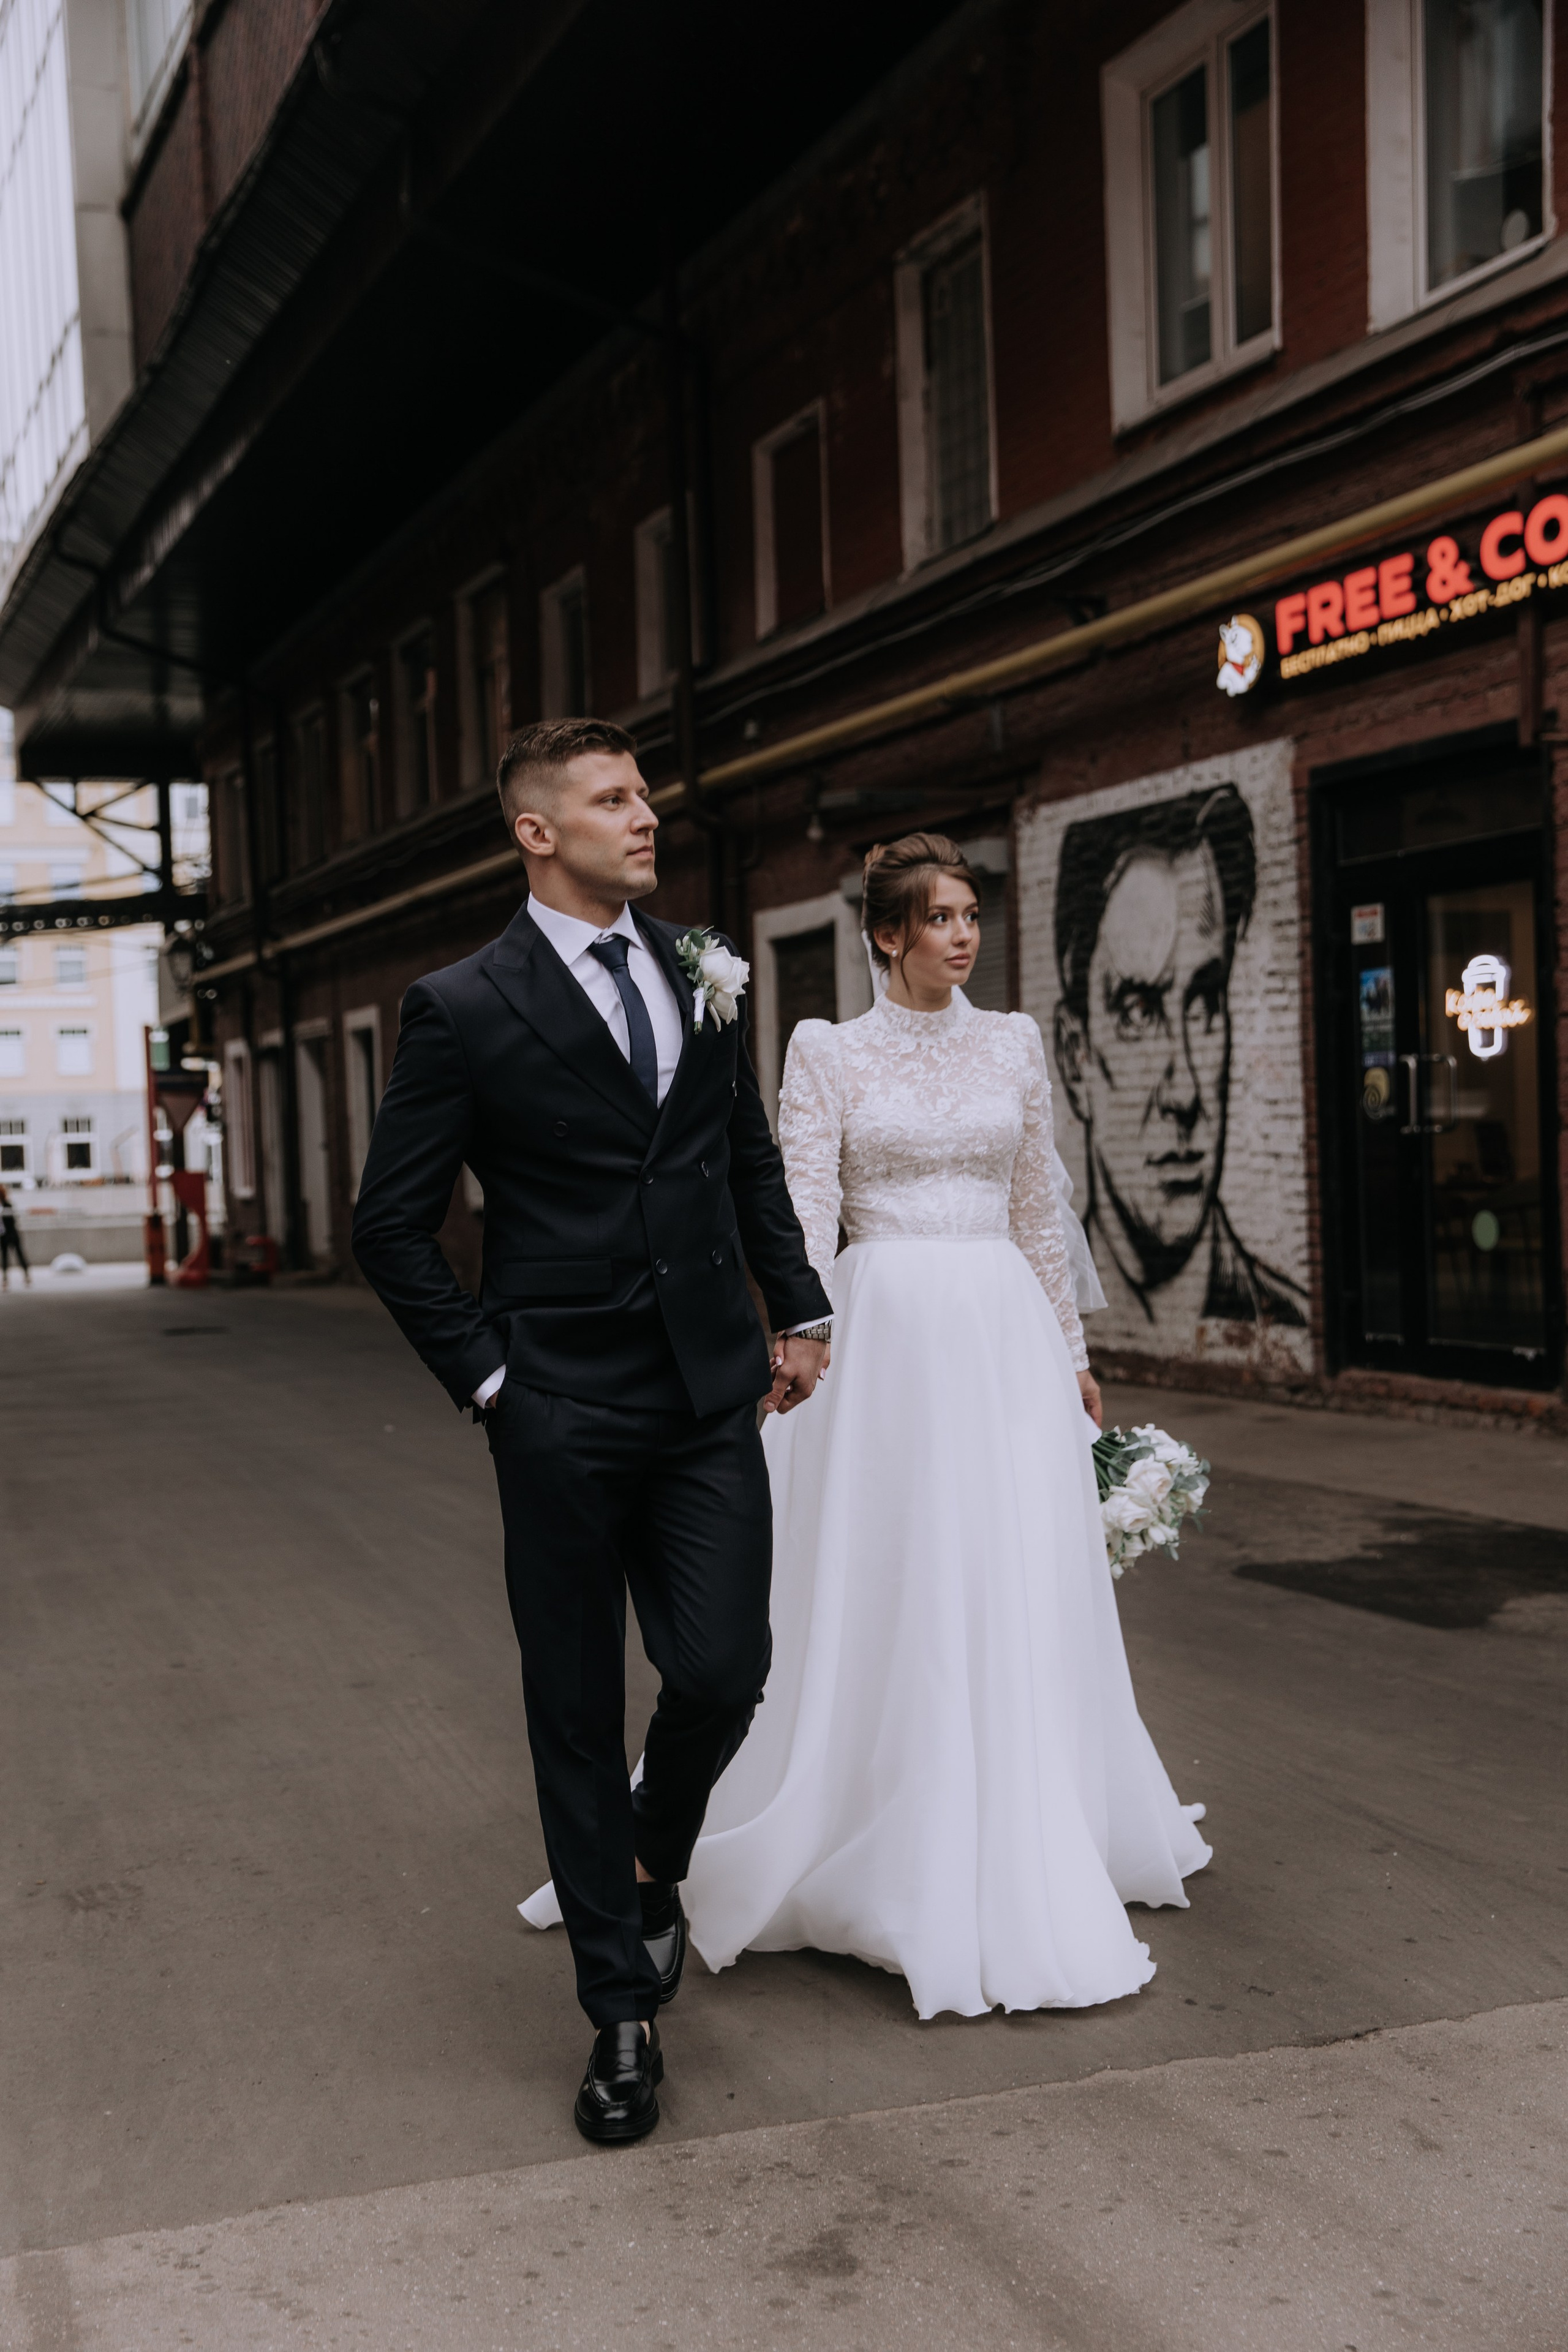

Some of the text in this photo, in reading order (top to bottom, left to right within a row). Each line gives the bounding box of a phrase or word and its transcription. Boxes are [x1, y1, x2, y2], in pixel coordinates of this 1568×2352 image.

[1275, 494, 1568, 655] FREE & CO
[1378, 607, 1440, 646] ПИЦЦА
[1449, 572, 1536, 623] ХОТ-ДОГ
